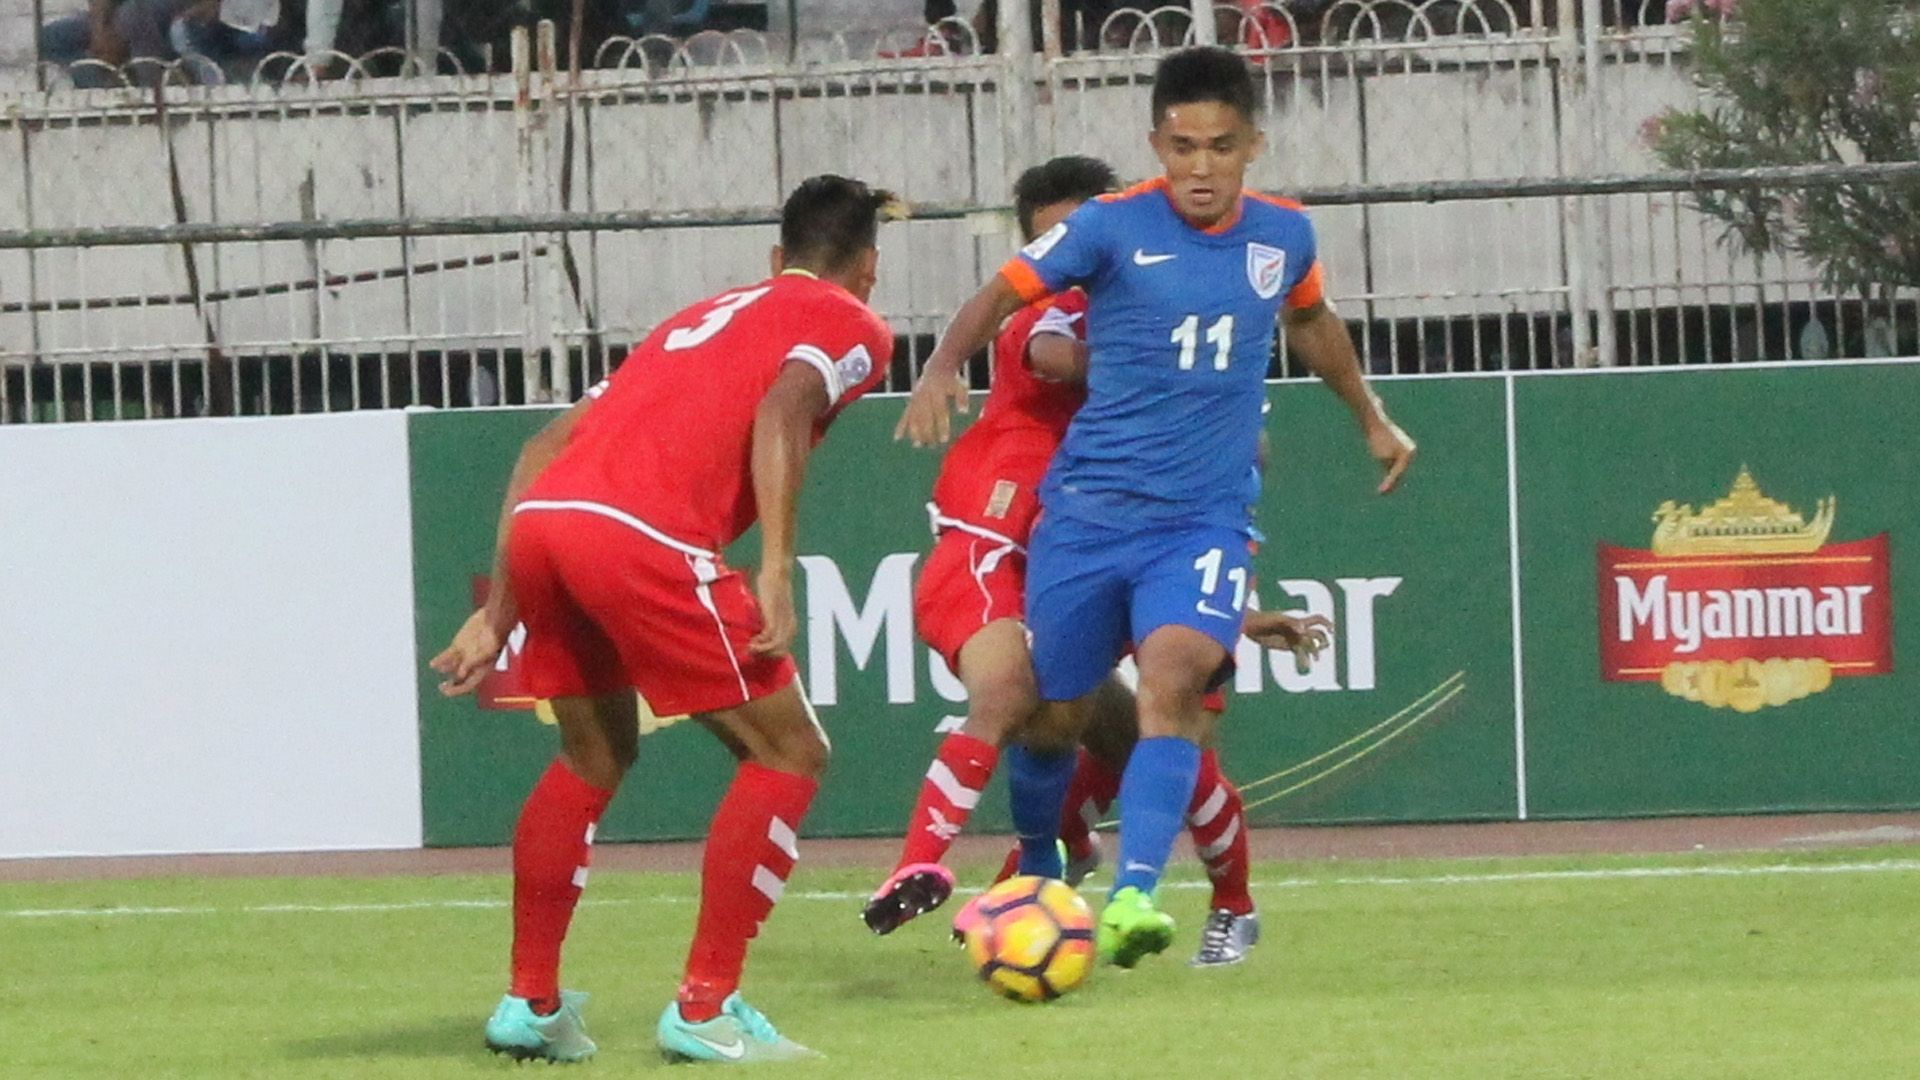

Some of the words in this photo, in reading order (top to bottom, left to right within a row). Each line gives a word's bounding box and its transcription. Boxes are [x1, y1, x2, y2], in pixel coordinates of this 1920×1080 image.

[663, 286, 773, 351] 3
[1170, 314, 1234, 371] 11
[1194, 547, 1247, 613] 11
[1614, 574, 1873, 653] Myanmar
